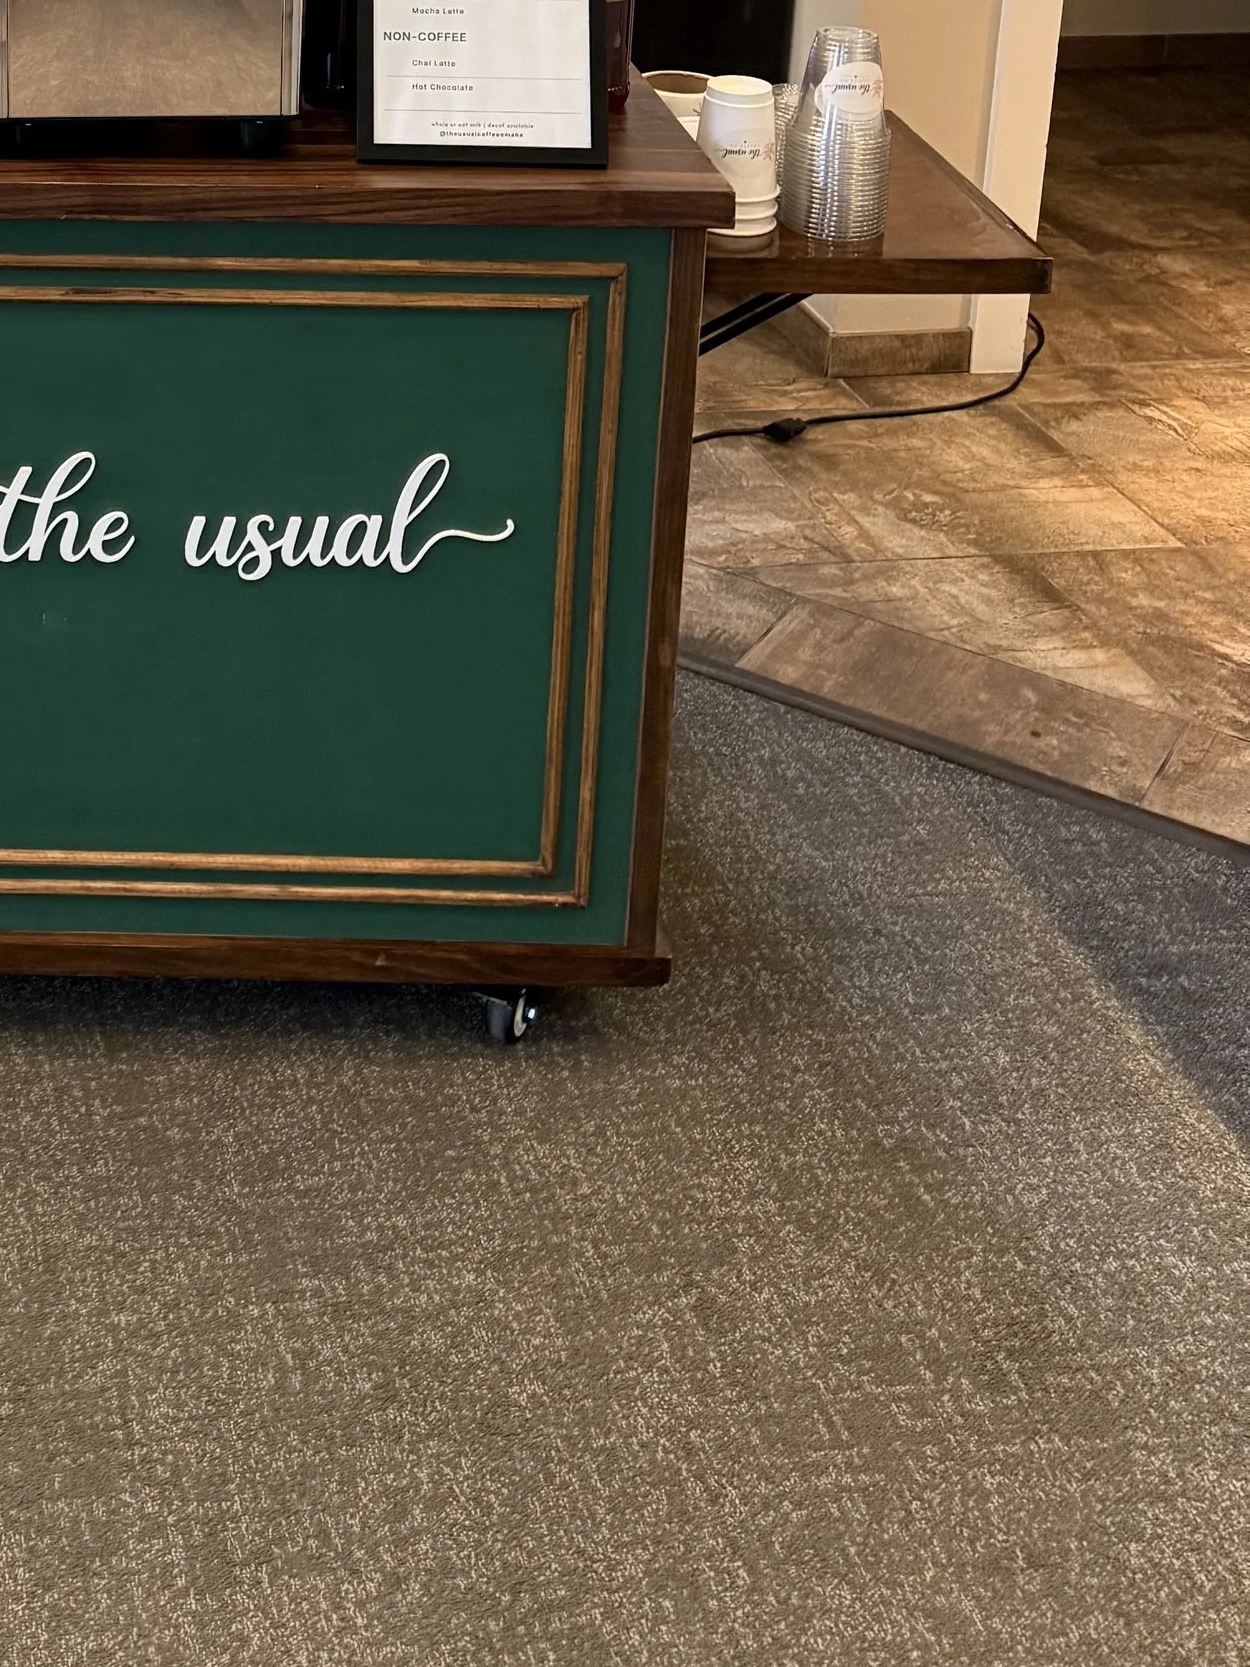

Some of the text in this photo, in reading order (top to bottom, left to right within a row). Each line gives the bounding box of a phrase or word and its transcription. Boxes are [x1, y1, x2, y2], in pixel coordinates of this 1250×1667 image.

[383, 31, 467, 42] NON-COFFEE
[411, 59, 432, 67] Chai
[412, 83, 474, 91] Hot Chocolate
[825, 84, 871, 95] the usual
[716, 148, 761, 159] the usual
[183, 452, 515, 581] usual
